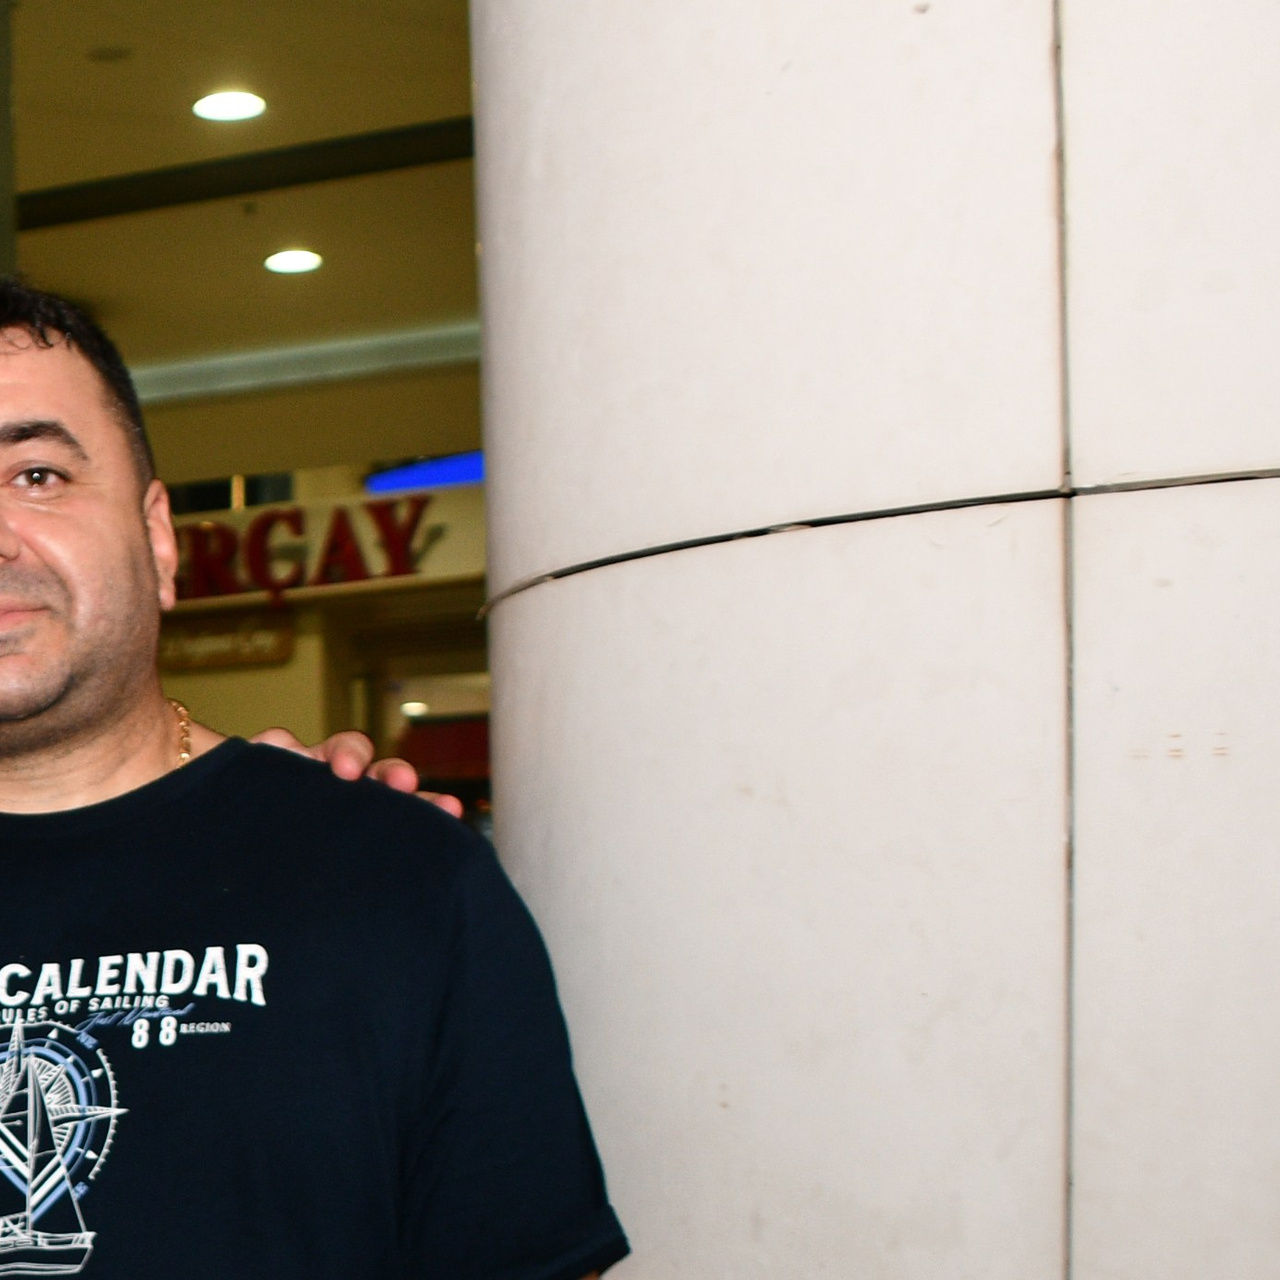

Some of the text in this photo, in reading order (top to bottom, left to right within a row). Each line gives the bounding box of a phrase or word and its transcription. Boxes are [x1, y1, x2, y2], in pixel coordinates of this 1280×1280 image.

[53, 999, 81, 1015] OF
[88, 994, 170, 1011] SAILING
[179, 1022, 232, 1034] REGION
